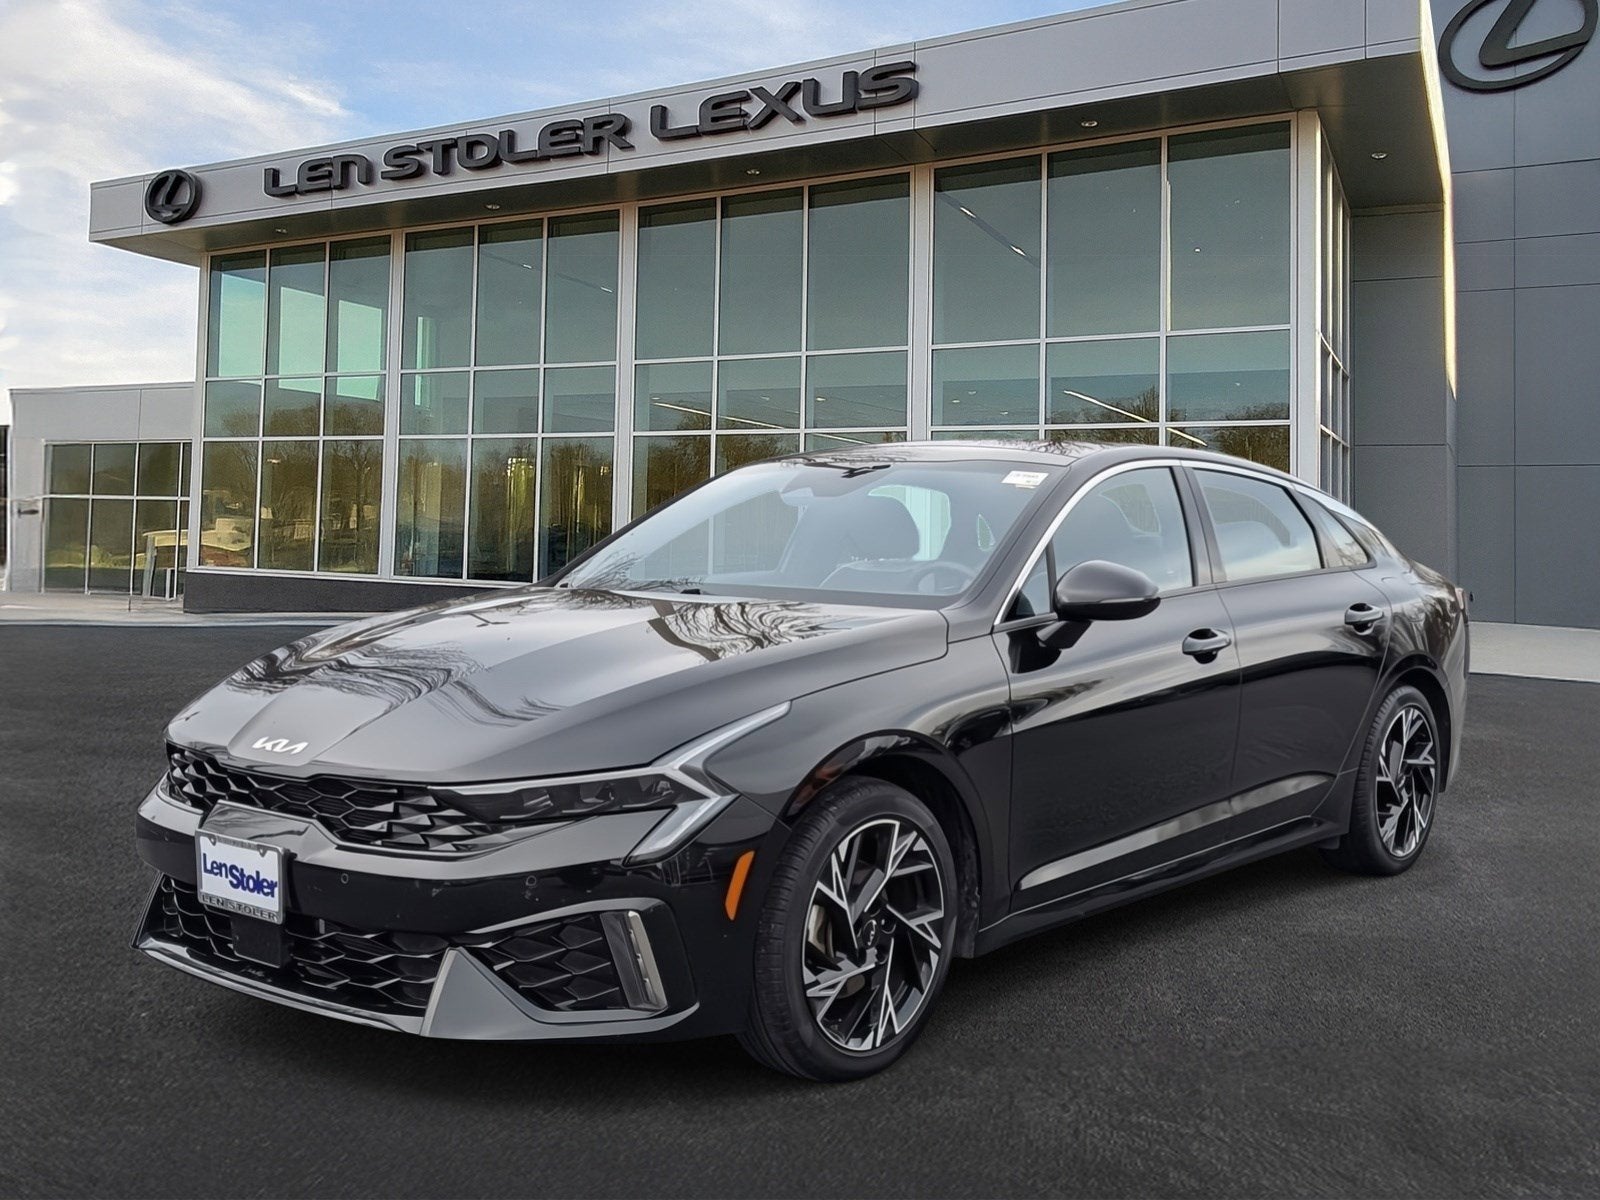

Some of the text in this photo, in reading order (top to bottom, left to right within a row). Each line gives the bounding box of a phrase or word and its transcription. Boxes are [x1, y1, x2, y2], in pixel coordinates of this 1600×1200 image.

[264, 60, 919, 197] LEN STOLER LEXUS
[202, 894, 278, 921] LEN STOLER
